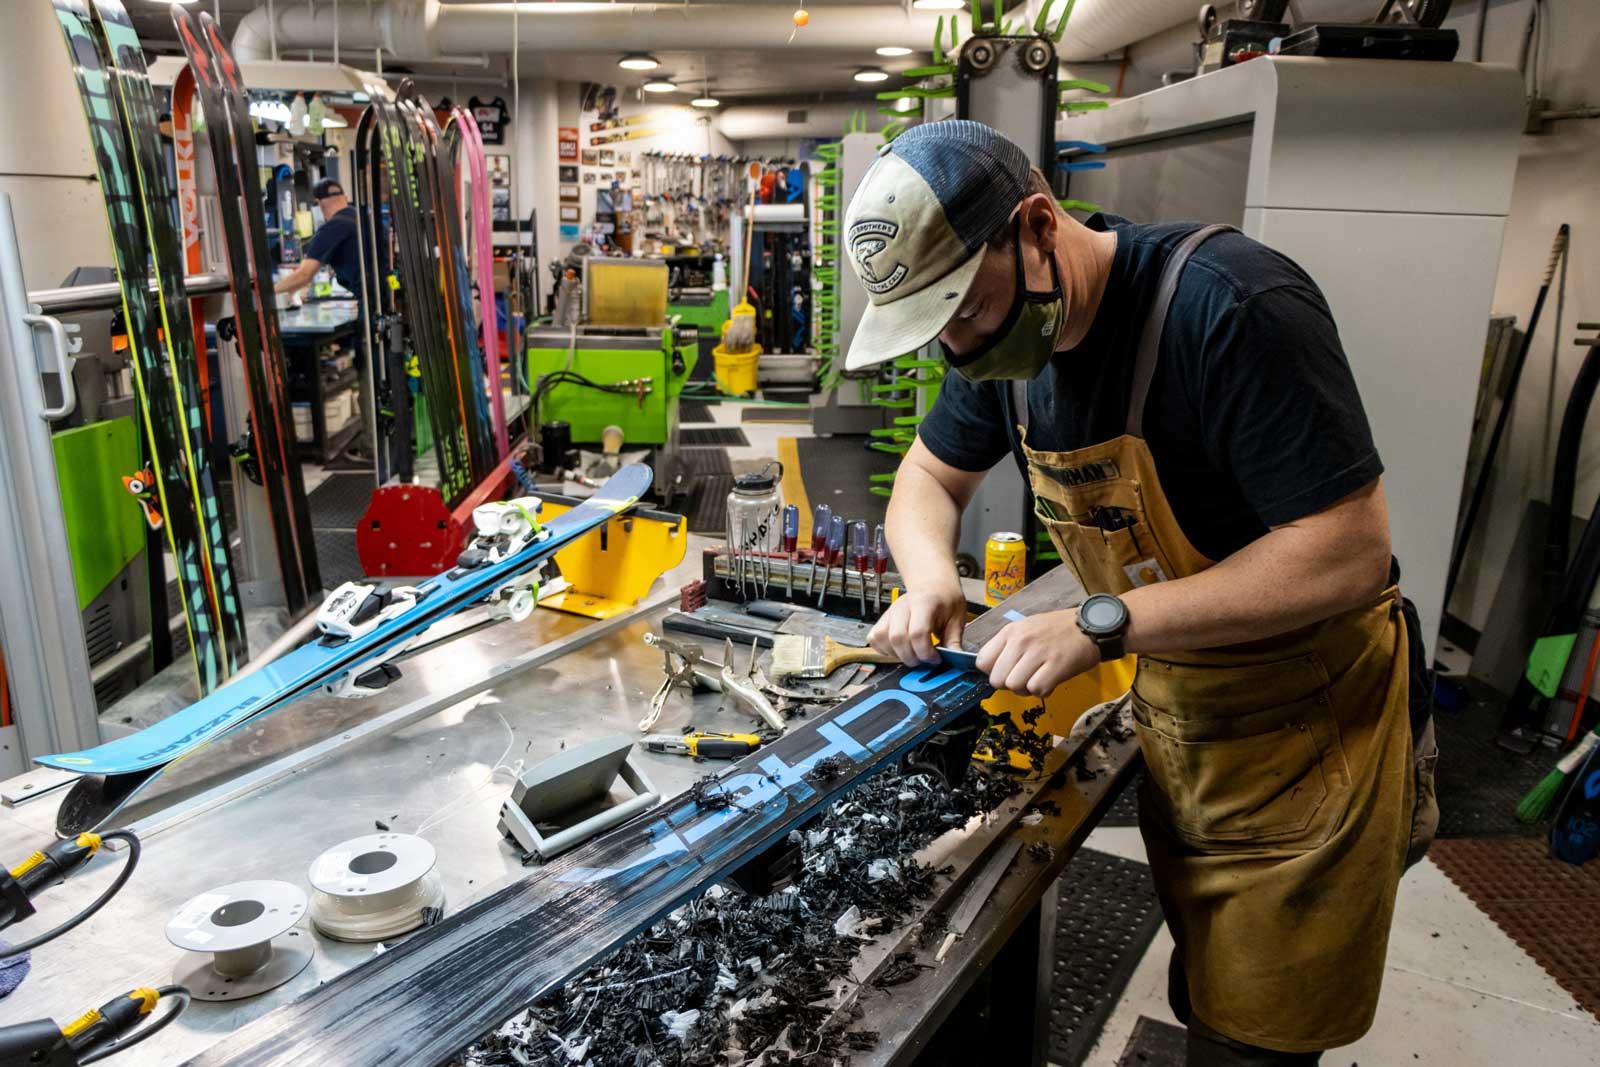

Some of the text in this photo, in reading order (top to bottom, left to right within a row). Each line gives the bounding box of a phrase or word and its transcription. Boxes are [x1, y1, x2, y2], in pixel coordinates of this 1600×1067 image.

[857, 224, 892, 233] BROTHERS
[889, 271, 903, 286] CALL
[136, 695, 261, 762] BLIZZARD
